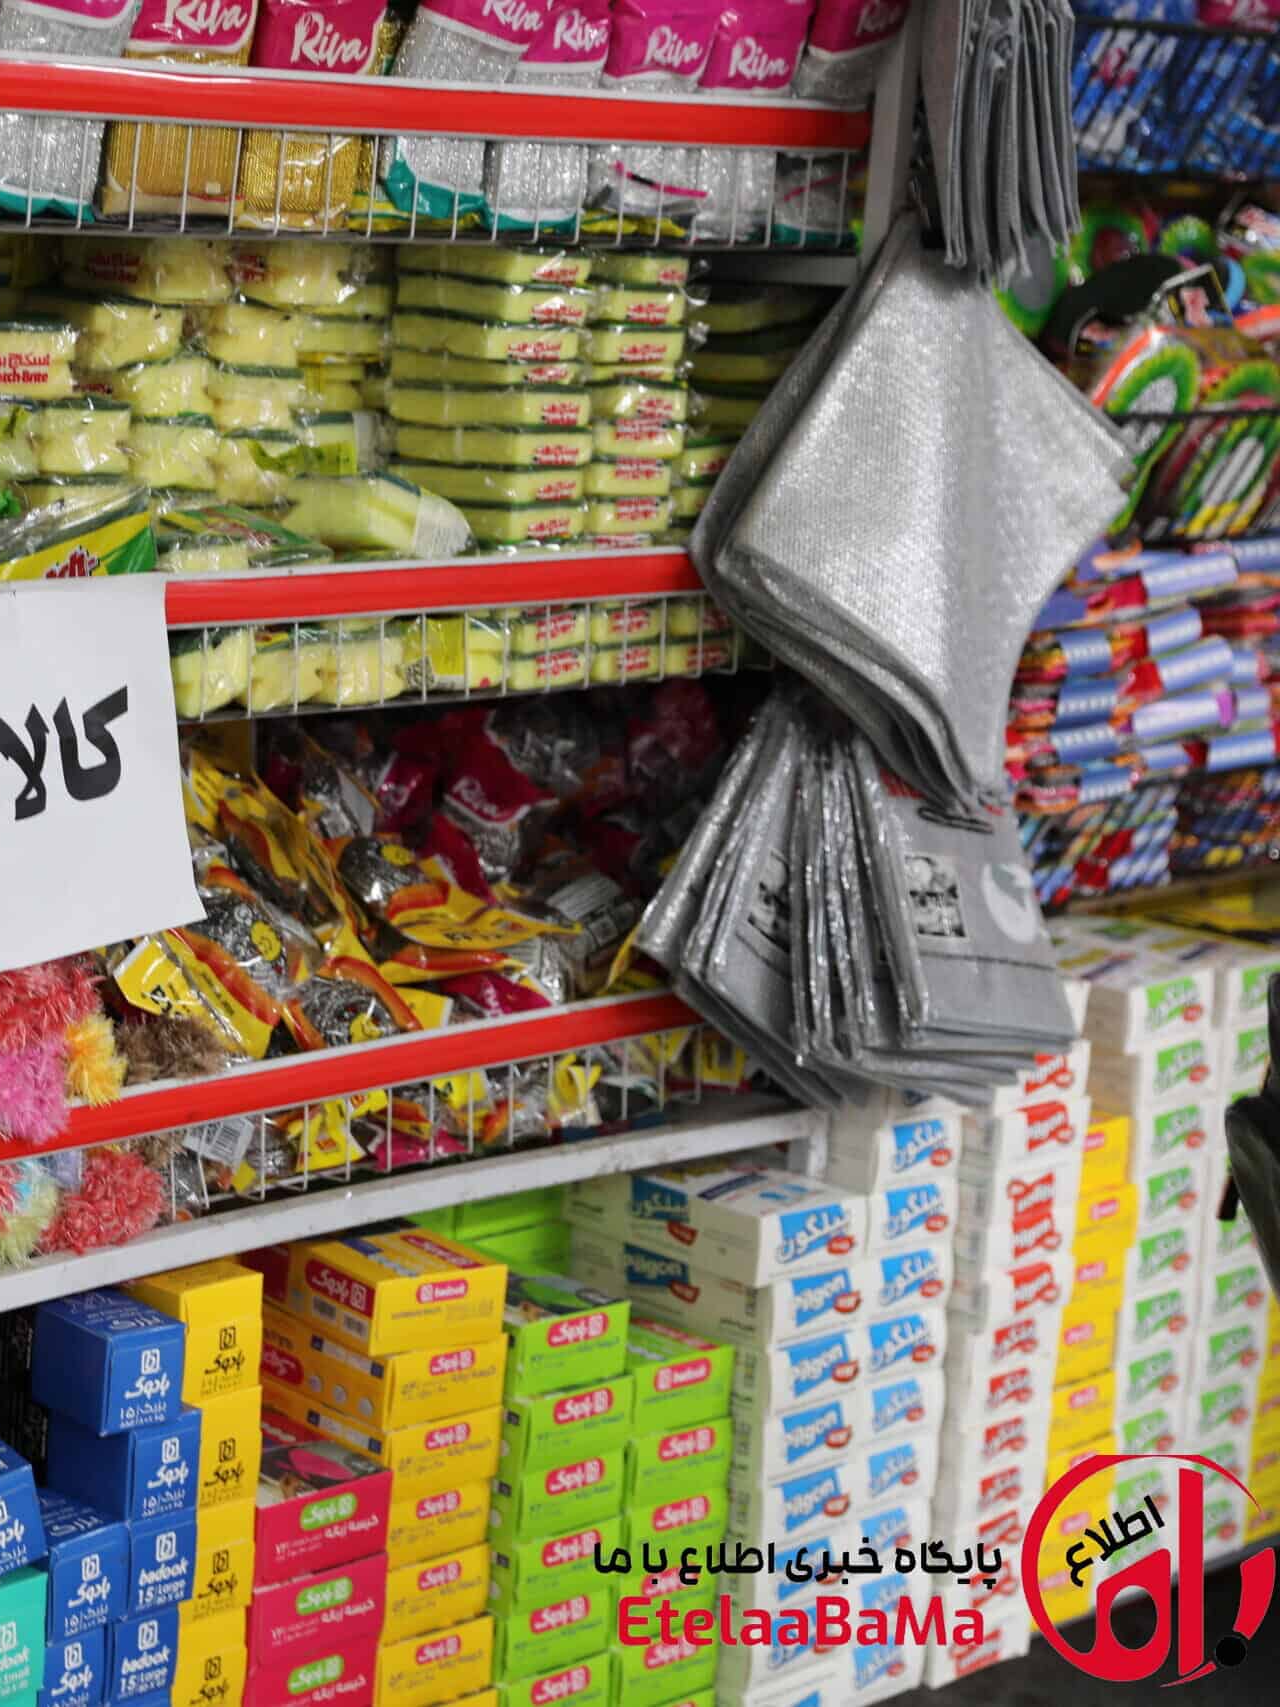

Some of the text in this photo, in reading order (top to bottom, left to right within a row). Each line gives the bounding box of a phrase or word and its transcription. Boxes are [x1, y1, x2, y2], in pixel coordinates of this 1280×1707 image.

[290, 12, 368, 67] Riva
[644, 26, 704, 66] Riva
[728, 37, 790, 80] Riva
[124, 1372, 170, 1399] بادوک
[147, 1460, 189, 1489] بادوک
[67, 1576, 111, 1608] بادوک
[51, 1663, 93, 1697] بادوک
